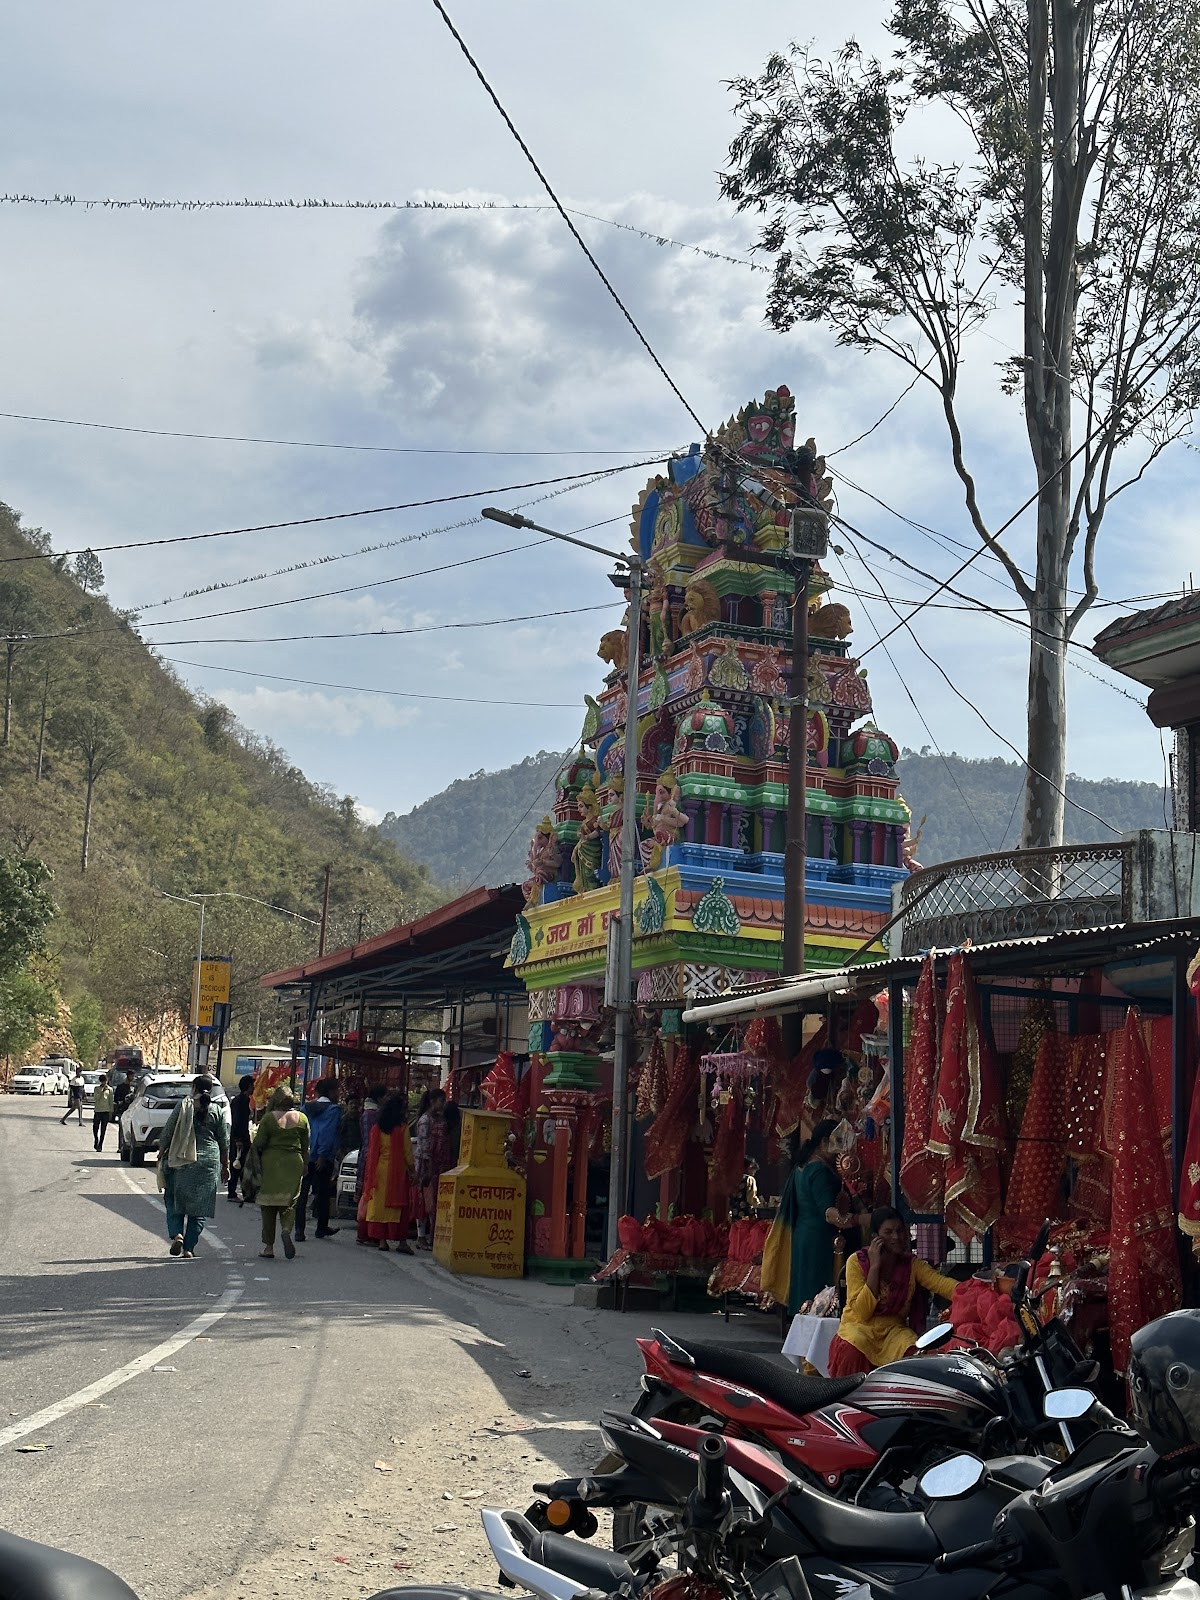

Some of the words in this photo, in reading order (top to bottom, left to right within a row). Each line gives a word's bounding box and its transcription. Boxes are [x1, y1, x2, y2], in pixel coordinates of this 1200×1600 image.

[546, 921, 572, 945] जय
[206, 964, 218, 972] LIFE
[208, 974, 215, 982] IS
[467, 1184, 517, 1202] दानपात्र
[458, 1206, 512, 1221] DONATION
[947, 1367, 982, 1381] HONDA
